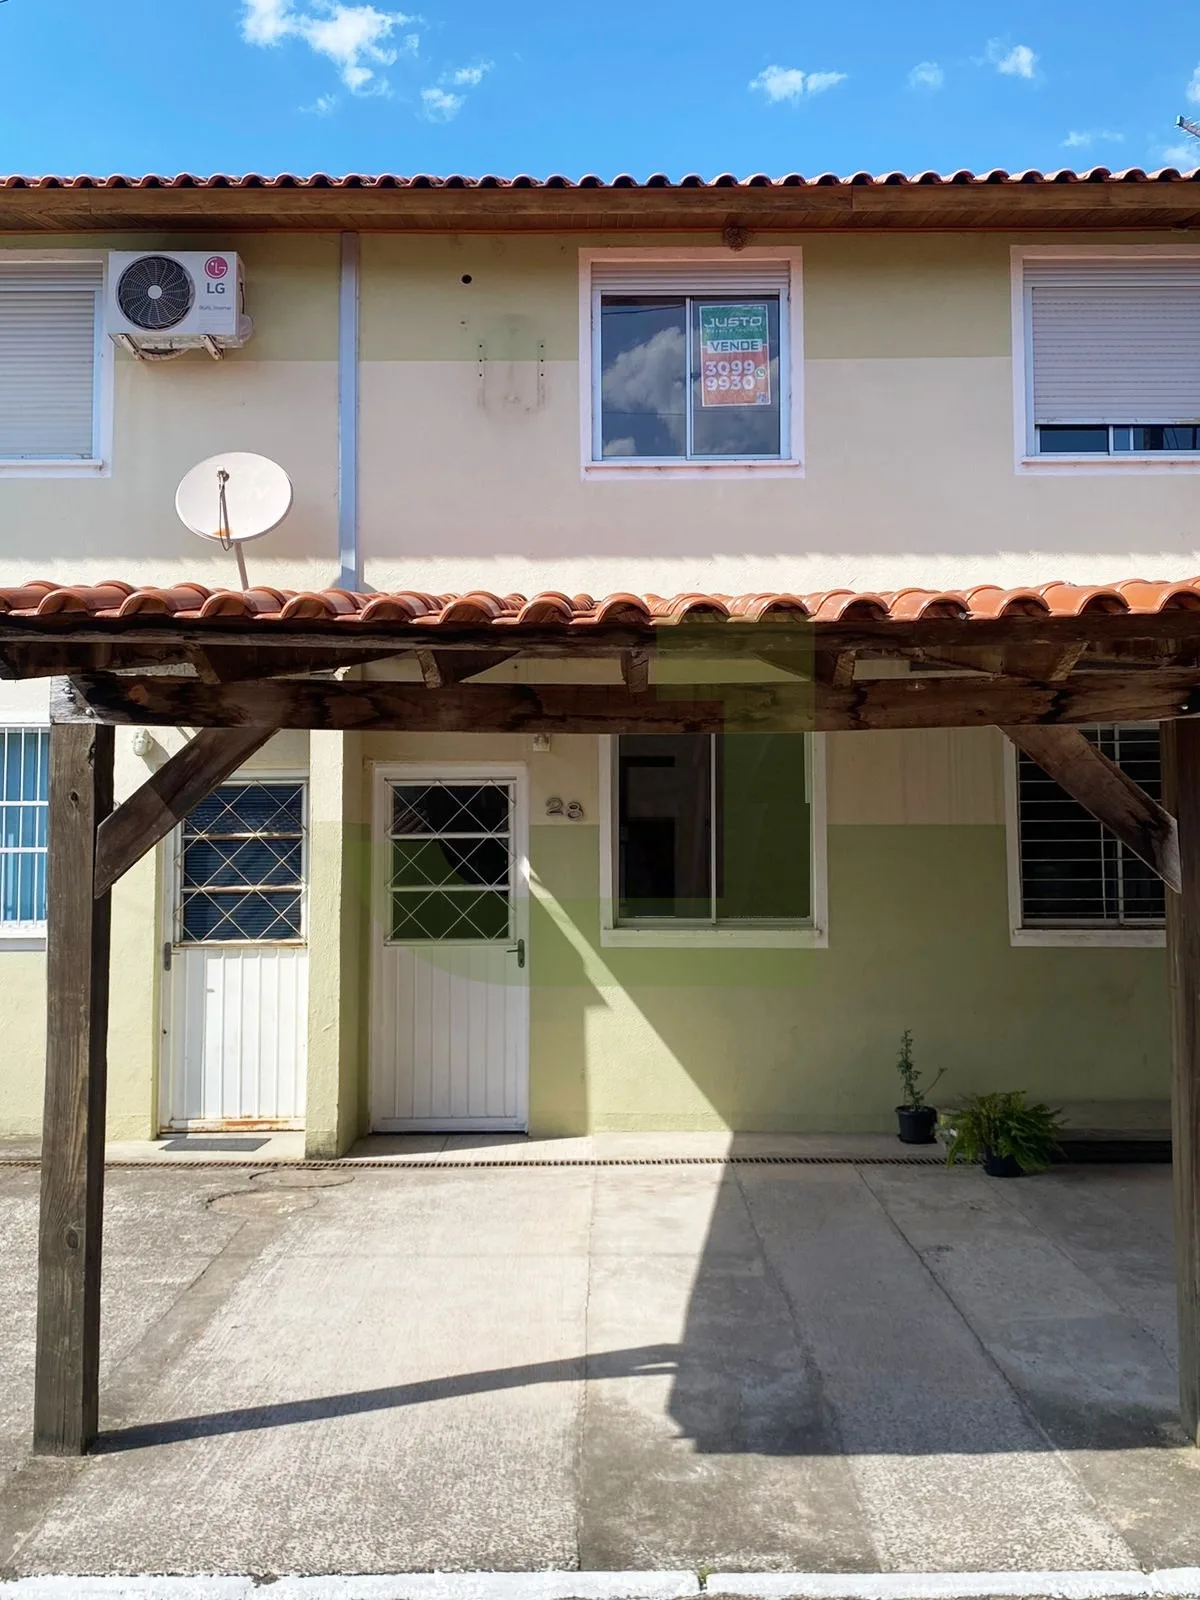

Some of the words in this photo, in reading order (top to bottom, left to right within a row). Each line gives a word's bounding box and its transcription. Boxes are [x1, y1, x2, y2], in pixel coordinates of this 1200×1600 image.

[206, 282, 225, 294] LG
[704, 317, 762, 328] JUSTO
[711, 341, 760, 352] VENDE
[706, 360, 755, 376] 3099
[706, 375, 755, 390] 9930
[545, 797, 584, 821] 28
